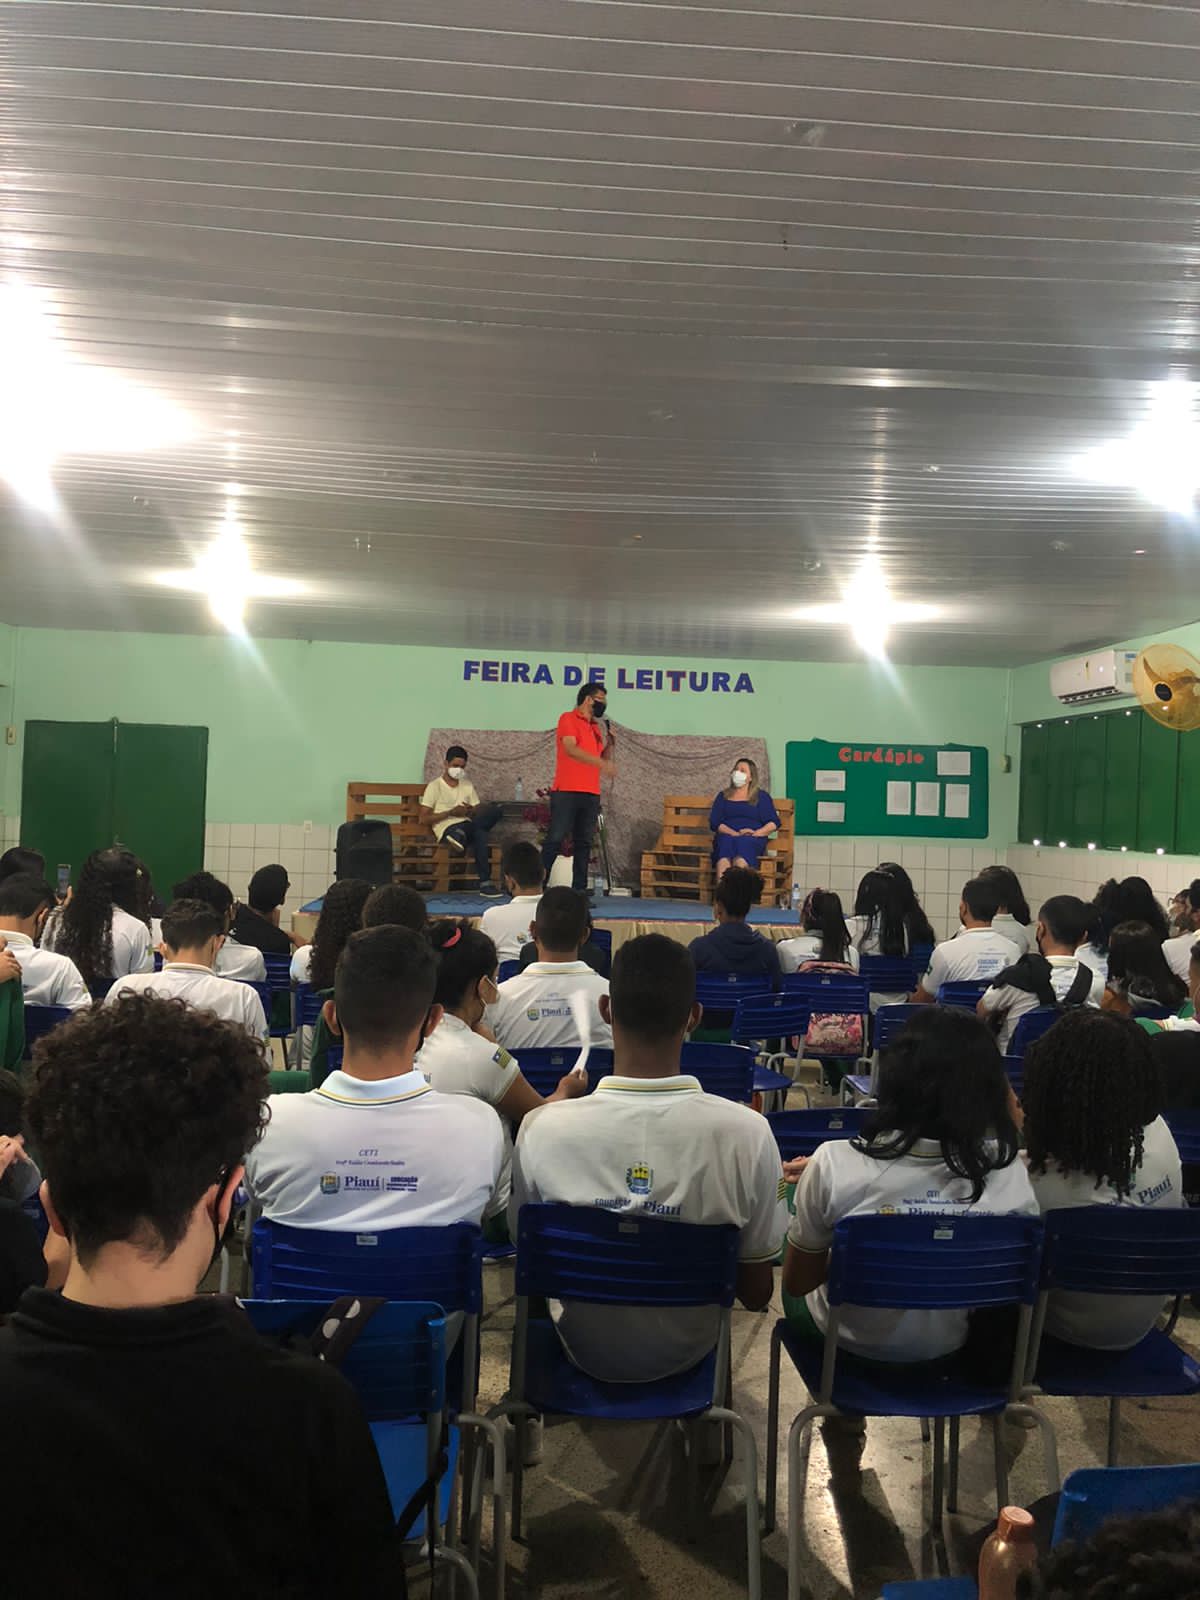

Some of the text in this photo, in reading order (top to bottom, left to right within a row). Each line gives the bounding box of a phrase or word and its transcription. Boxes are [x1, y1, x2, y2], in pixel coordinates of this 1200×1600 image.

[463, 660, 754, 694] FEIRA DE LEITURA
[838, 747, 924, 766] Cardápio
[344, 1175, 380, 1187] Piauí
